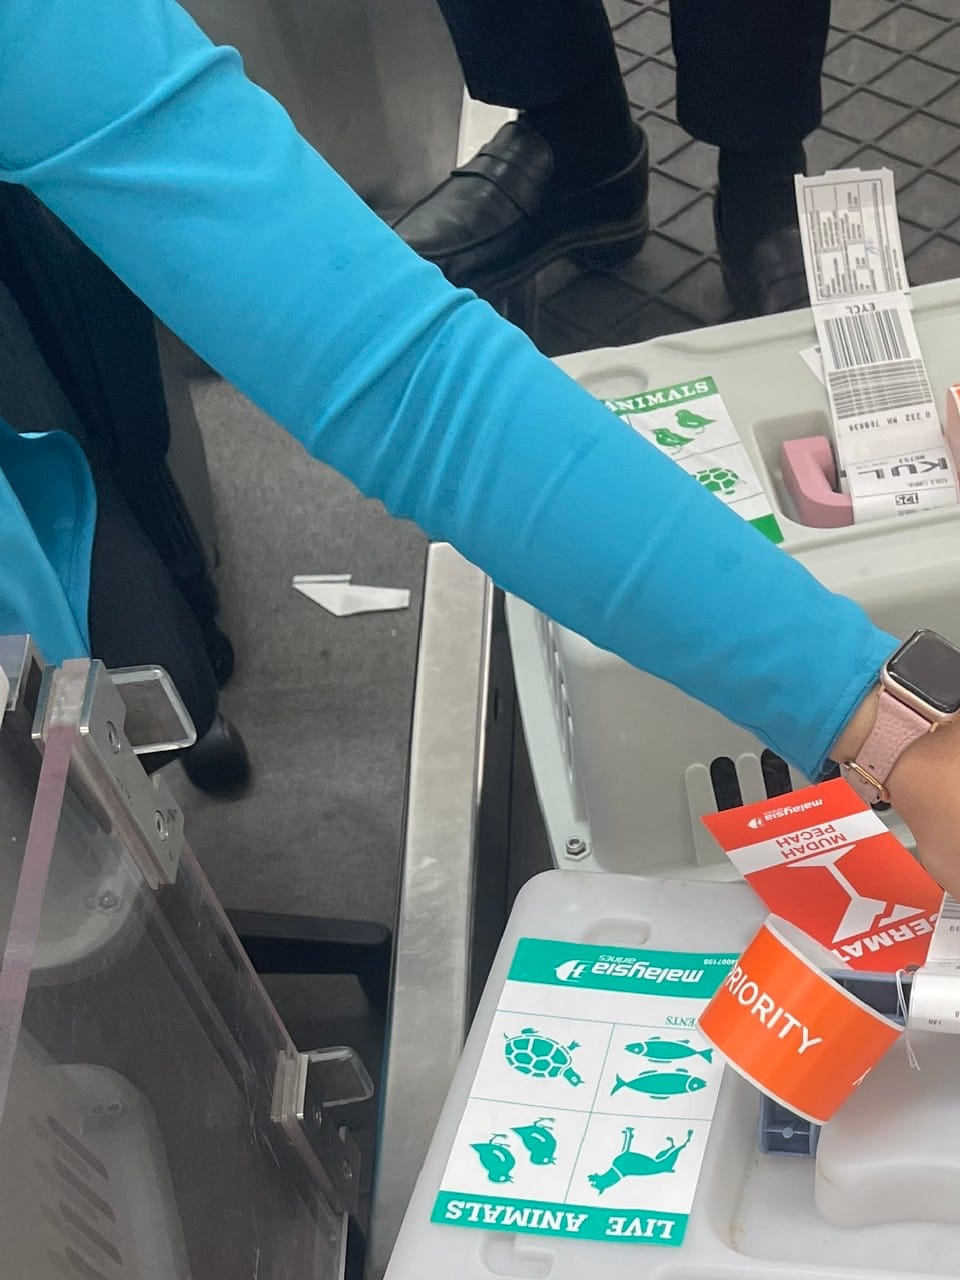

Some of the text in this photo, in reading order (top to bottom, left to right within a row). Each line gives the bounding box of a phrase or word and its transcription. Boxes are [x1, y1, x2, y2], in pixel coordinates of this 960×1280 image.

[845, 302, 876, 314] EYCL
[857, 457, 948, 479] KUL
[895, 493, 919, 505] 125
[764, 799, 823, 821] malaysia
[775, 823, 837, 848] PECAH
[781, 832, 847, 860] MUDAH
[591, 961, 705, 984] malaysia
[665, 1015, 698, 1027] ENTS
[445, 1199, 676, 1239] LIVE ANIMALS
